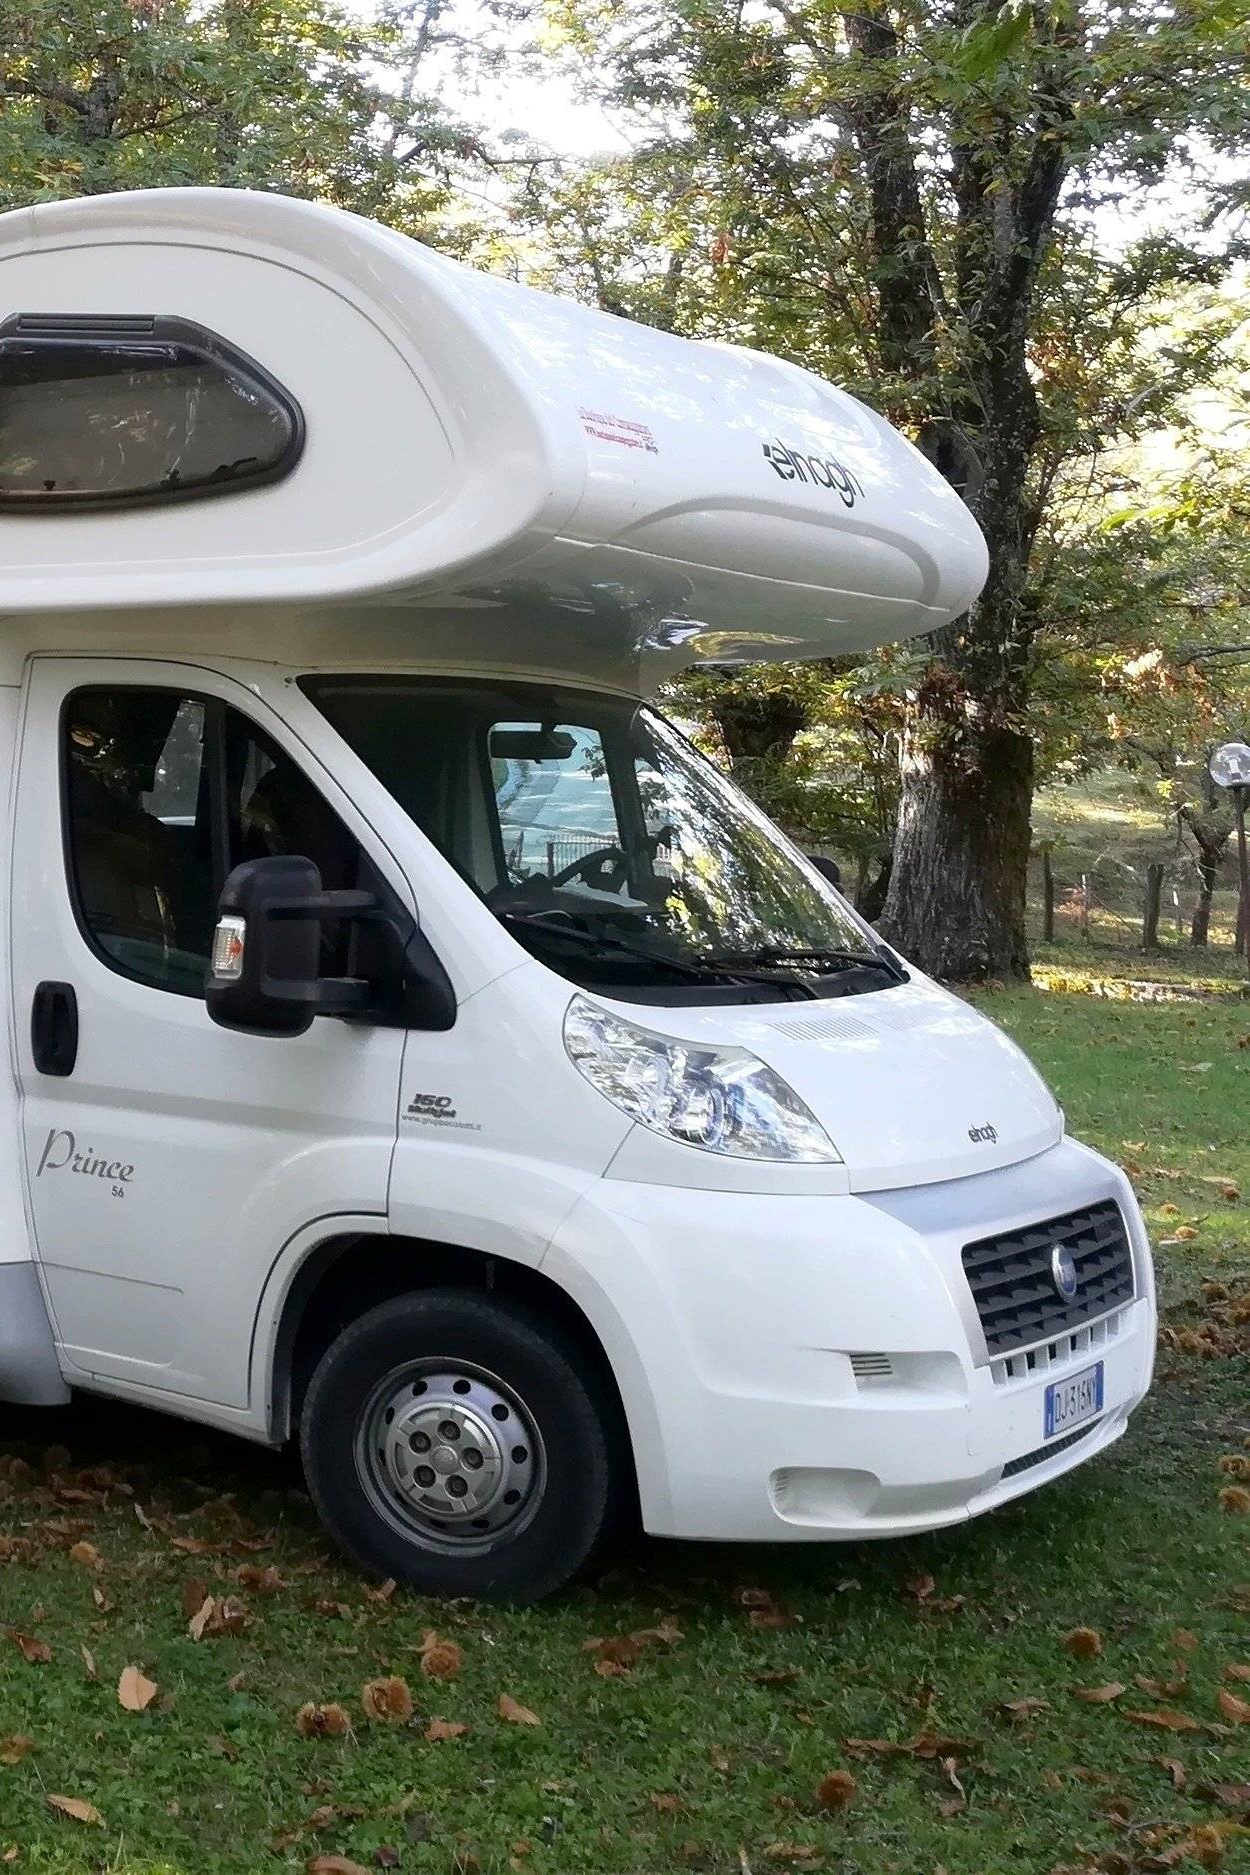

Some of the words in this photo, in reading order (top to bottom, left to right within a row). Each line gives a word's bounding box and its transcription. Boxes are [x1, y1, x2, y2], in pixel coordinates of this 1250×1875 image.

[762, 437, 865, 508] elnagh
[413, 1094, 452, 1107] 160
[36, 1129, 135, 1182] Prince
[111, 1185, 124, 1199] 56
